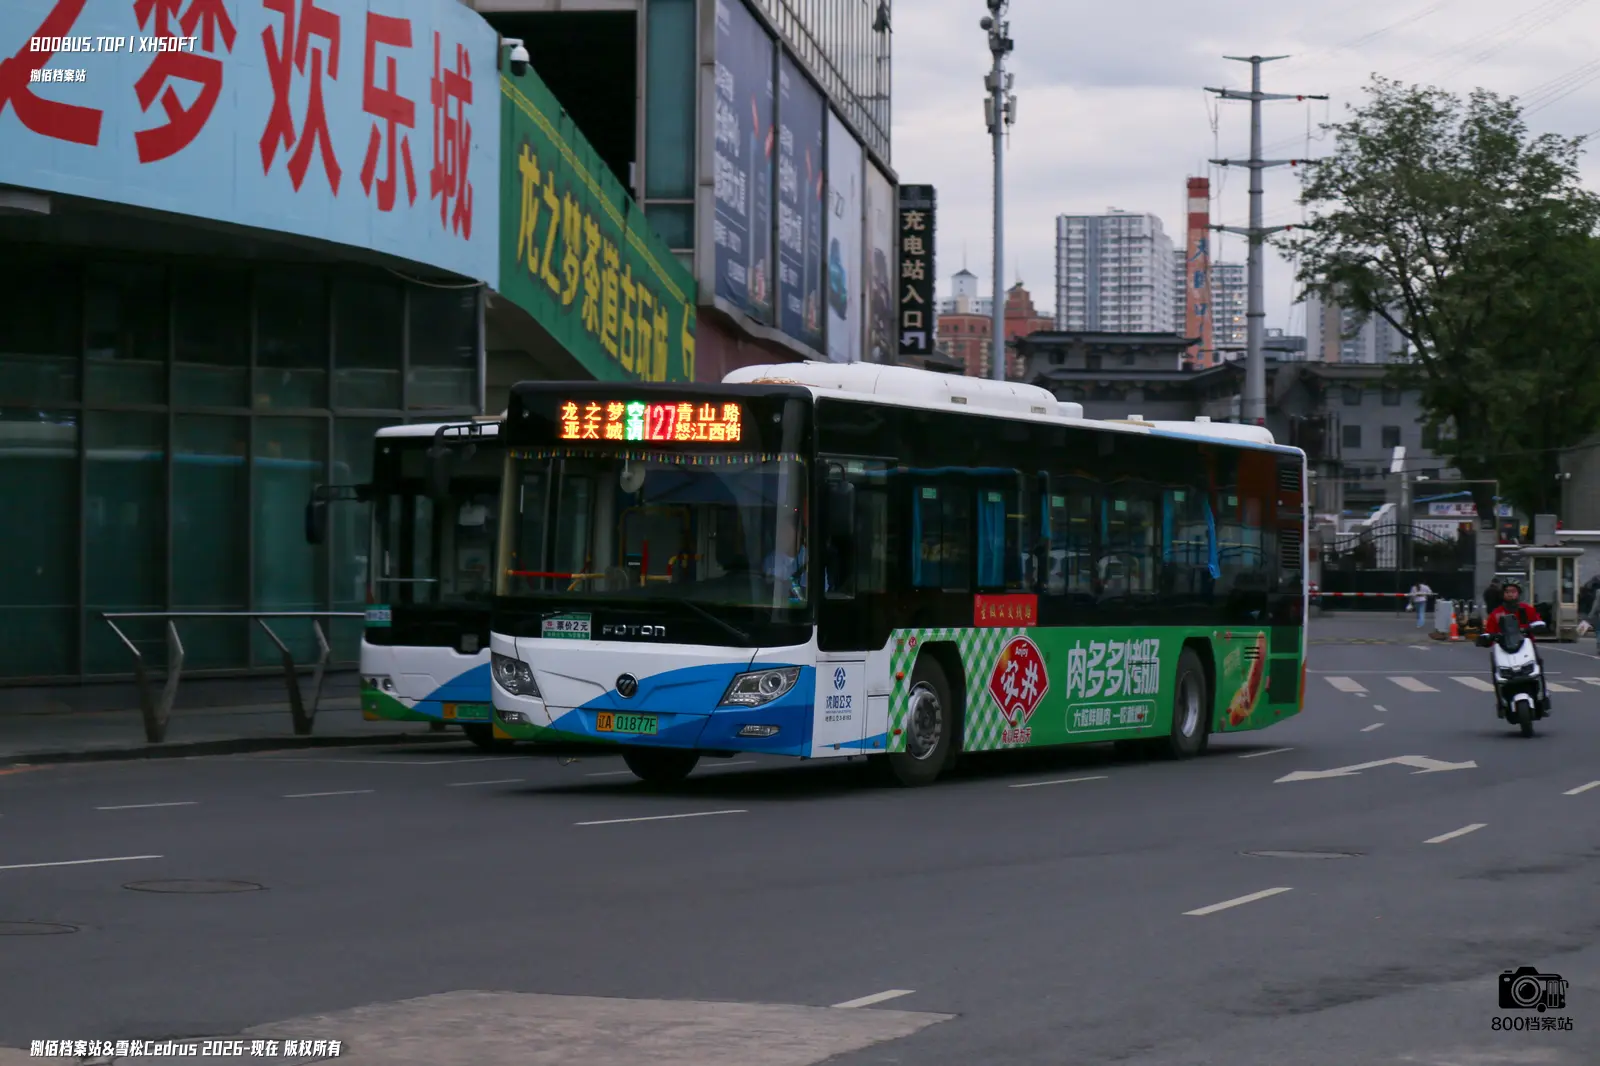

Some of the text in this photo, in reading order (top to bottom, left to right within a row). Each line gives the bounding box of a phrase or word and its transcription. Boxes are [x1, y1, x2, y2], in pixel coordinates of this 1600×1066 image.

[902, 210, 926, 328] 充电站入口
[562, 401, 624, 421] 龙之梦
[677, 403, 740, 421] 青山路
[562, 420, 624, 440] 亚太城
[644, 404, 676, 440] 127
[675, 422, 741, 441] 怒江西街
[556, 620, 589, 632] 票价2元
[1066, 638, 1160, 699] 肉多多烤肠
[1001, 660, 1039, 706] 安井
[826, 694, 852, 709] 沈阳公交
